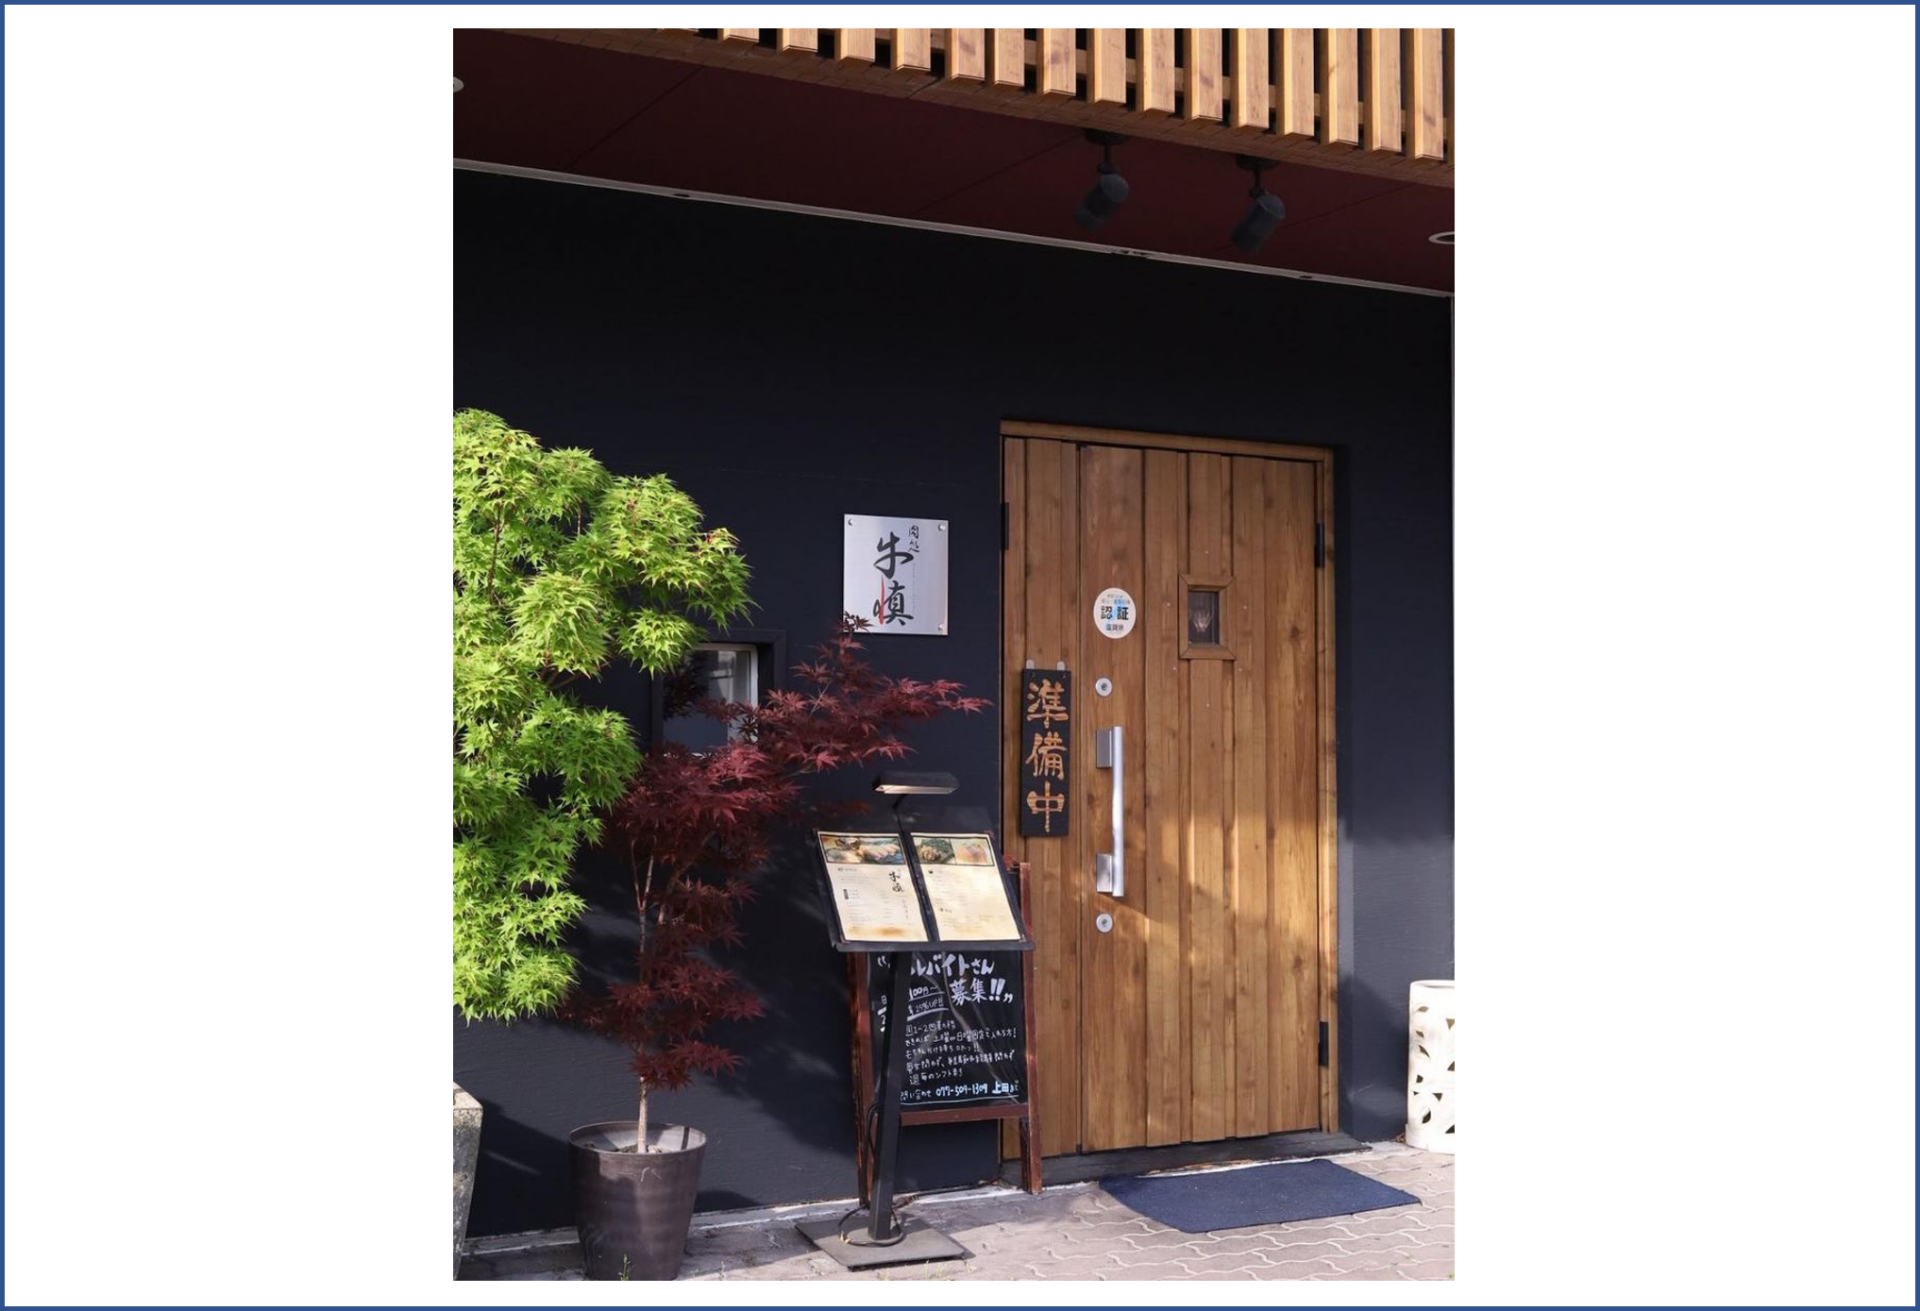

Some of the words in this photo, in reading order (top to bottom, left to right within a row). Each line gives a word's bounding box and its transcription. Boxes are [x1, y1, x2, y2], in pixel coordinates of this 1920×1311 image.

[1100, 605, 1129, 620] 認証
[1025, 678, 1069, 833] 準備中
